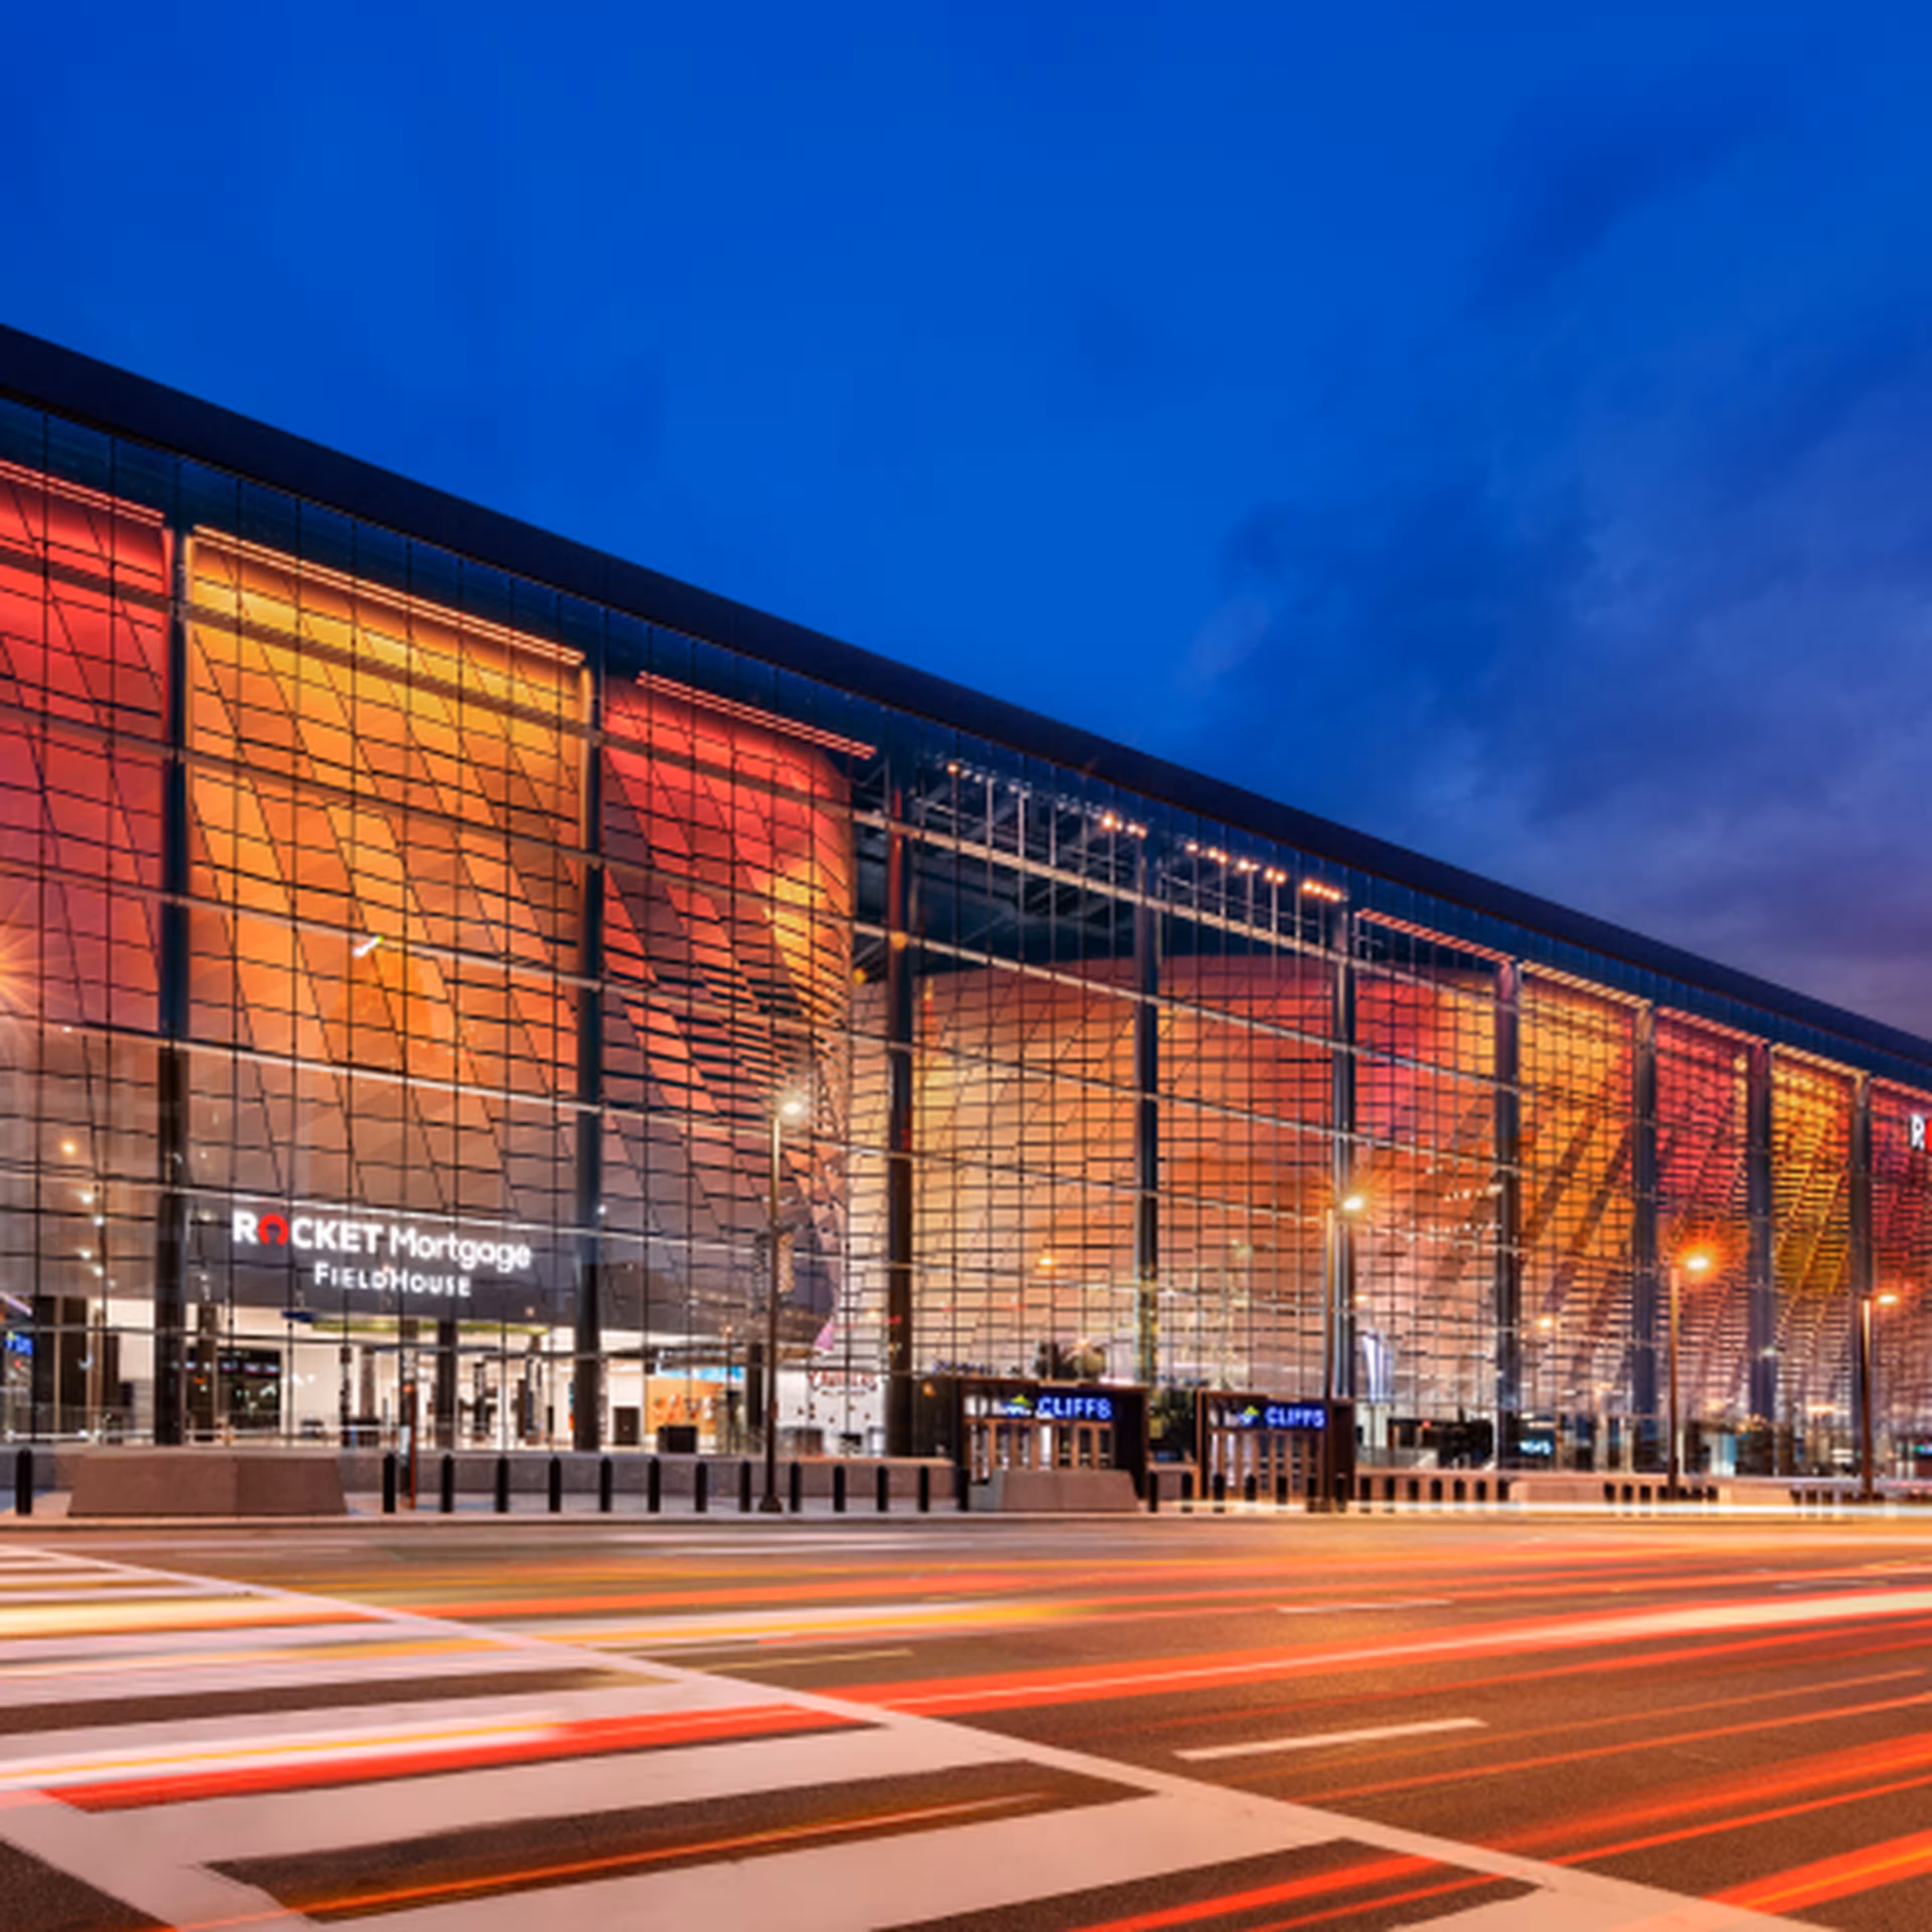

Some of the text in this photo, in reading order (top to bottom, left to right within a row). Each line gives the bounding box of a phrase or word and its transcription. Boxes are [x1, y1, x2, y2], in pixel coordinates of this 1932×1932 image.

[232, 1210, 532, 1273] ROCKET Mortgage
[1037, 1396, 1112, 1419] CLIFFS
